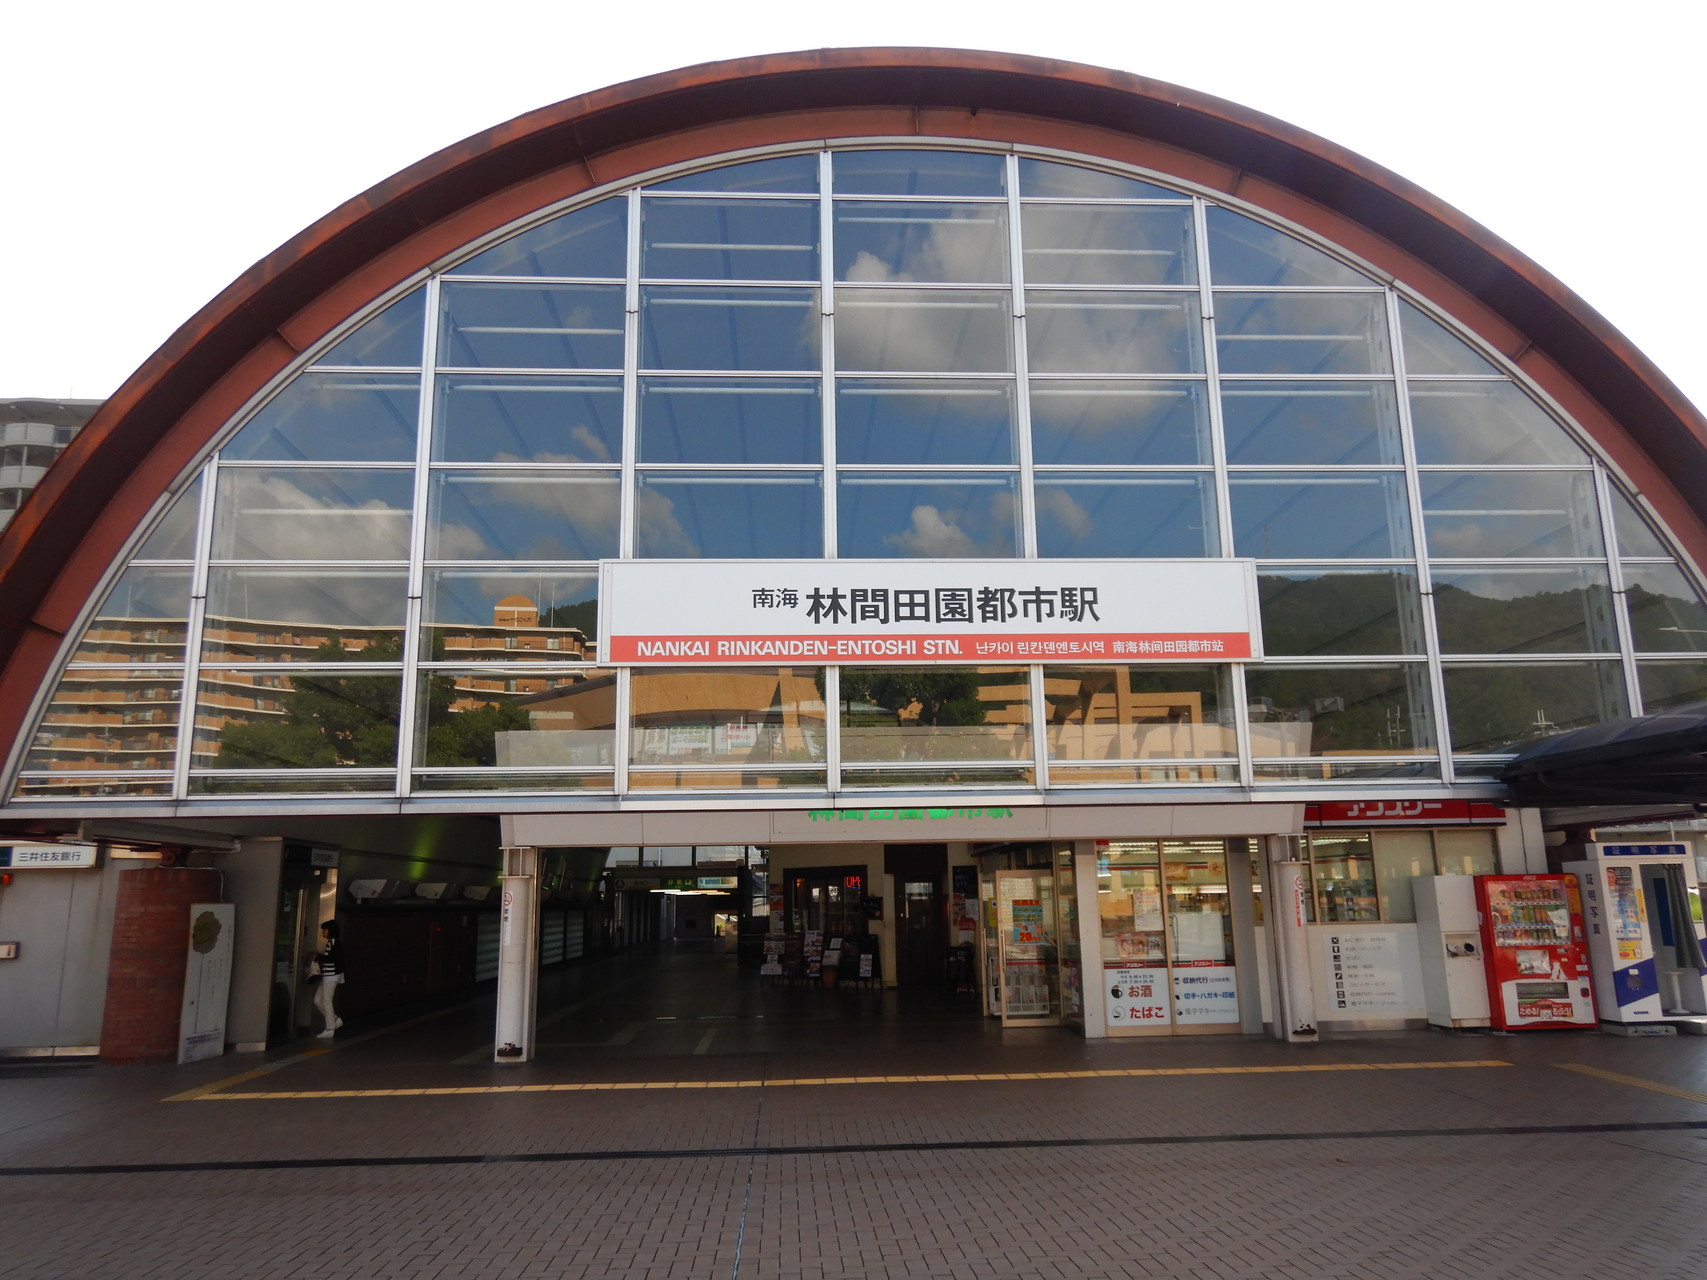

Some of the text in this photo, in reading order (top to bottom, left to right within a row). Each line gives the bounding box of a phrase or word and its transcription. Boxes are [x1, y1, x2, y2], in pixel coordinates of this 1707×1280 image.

[751, 586, 1101, 625] 南海 林間田園都市駅
[637, 638, 963, 657] NANKAI RINKANDEN-ENTOSHI STN.
[975, 640, 1105, 656] 난카이 린칸덴엔토시역
[1112, 639, 1225, 654] 南海林间田园都市站
[18, 850, 82, 863] 三井住友銀行
[1128, 984, 1153, 998] お酒
[1129, 1006, 1165, 1019] たばこ
